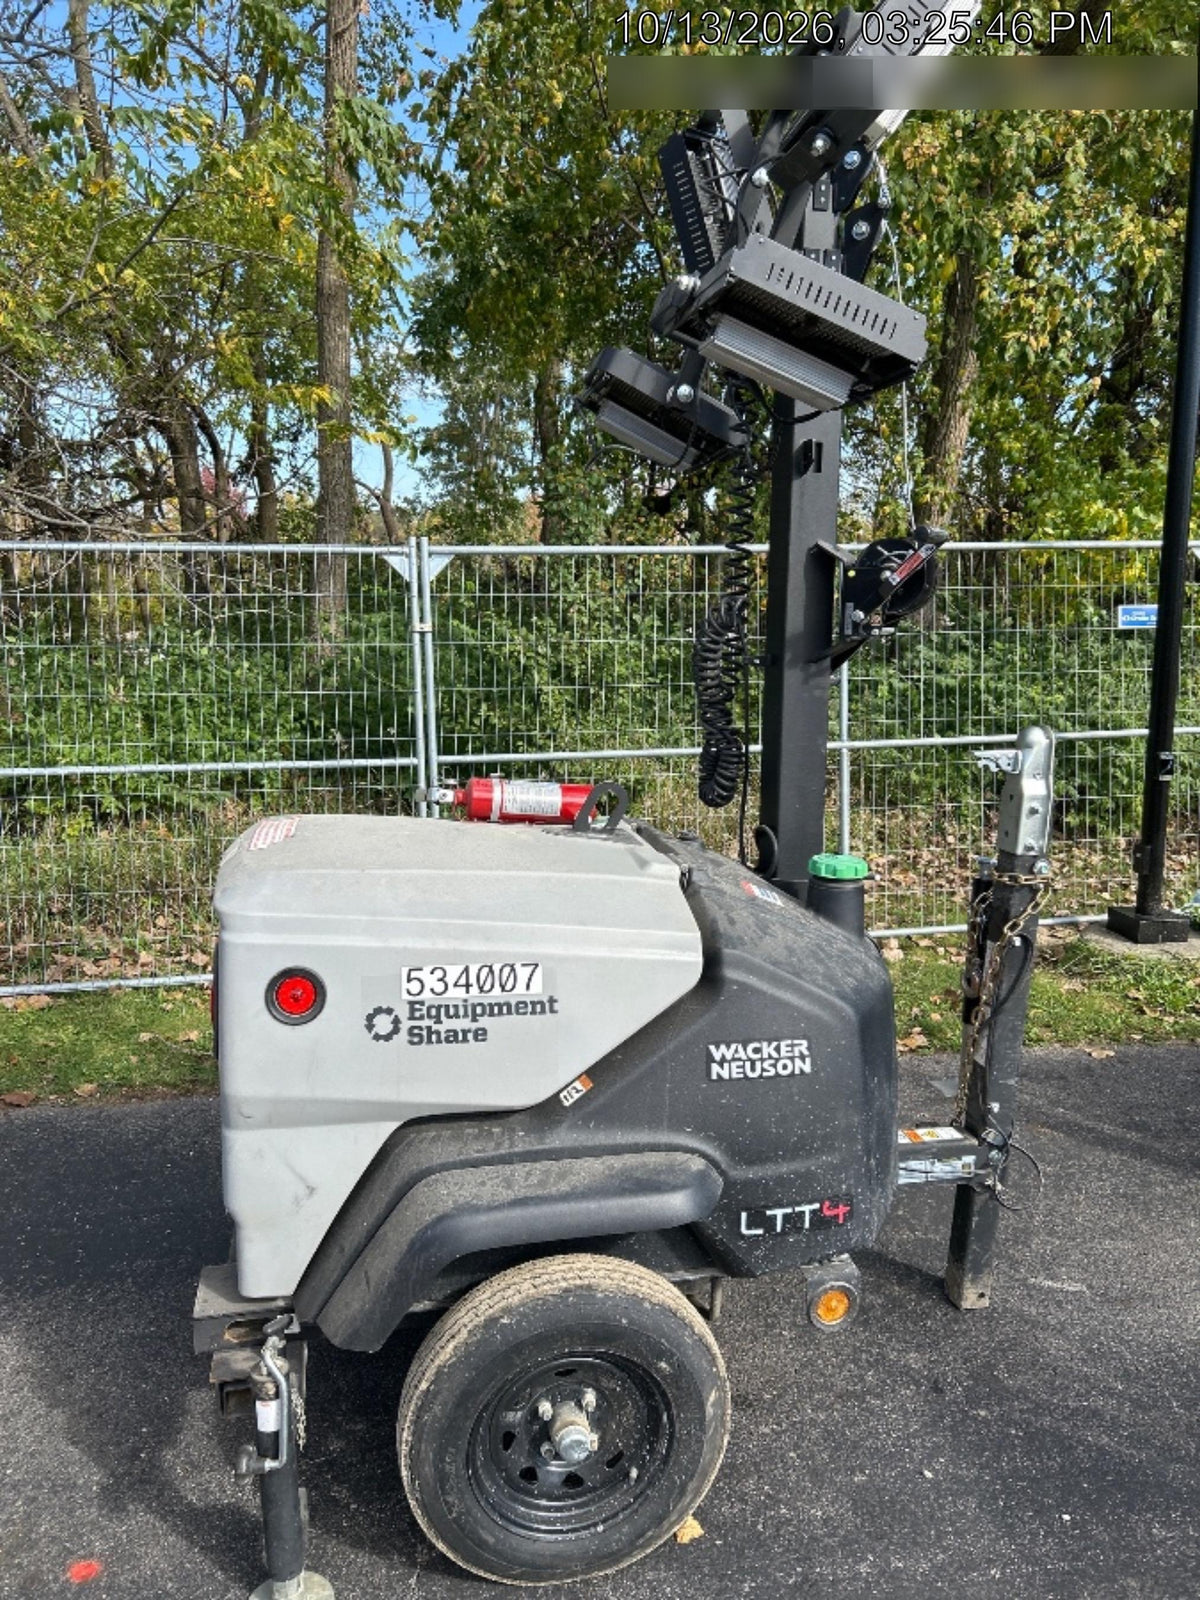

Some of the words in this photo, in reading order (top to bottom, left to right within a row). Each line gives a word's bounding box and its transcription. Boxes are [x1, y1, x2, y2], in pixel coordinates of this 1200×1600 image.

[405, 963, 540, 996] 534007
[406, 995, 559, 1025] Equipment
[406, 1025, 489, 1046] Share
[708, 1039, 810, 1061] WACKER
[710, 1057, 812, 1080] NEUSON
